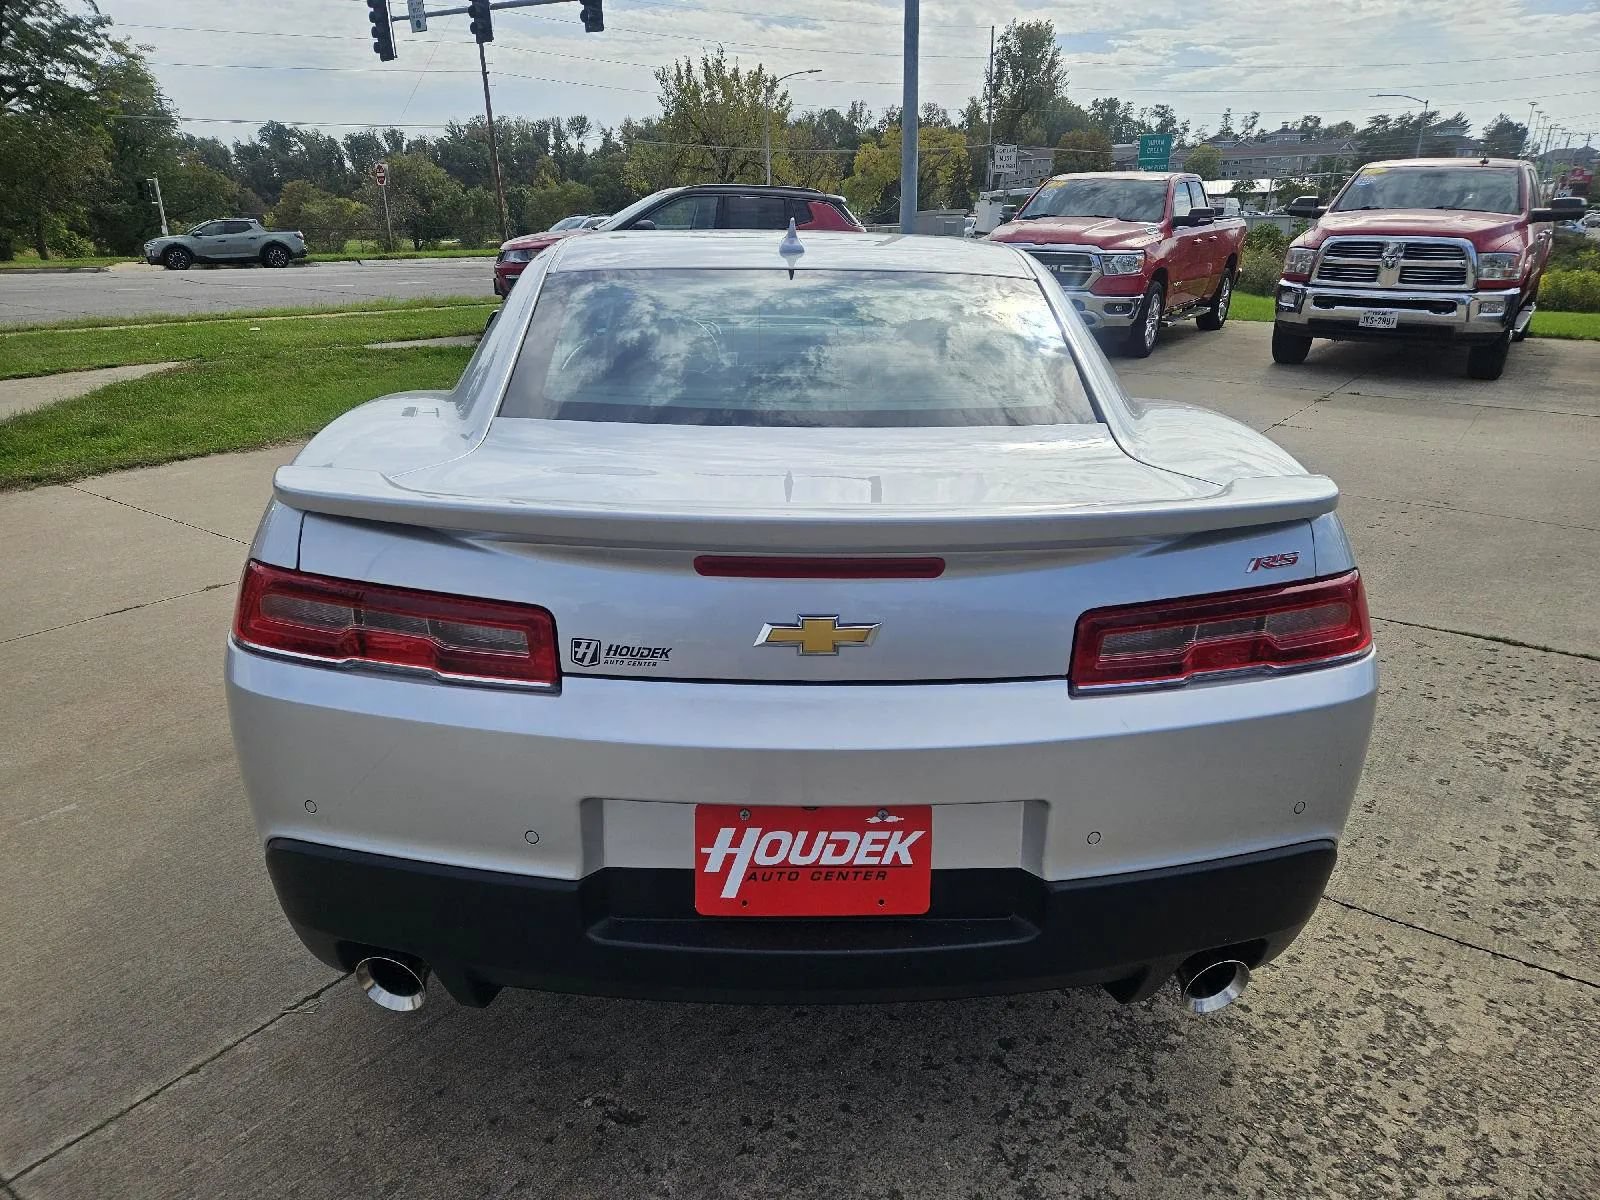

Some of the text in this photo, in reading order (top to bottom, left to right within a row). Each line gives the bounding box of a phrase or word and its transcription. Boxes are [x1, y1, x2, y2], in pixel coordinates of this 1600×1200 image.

[1245, 551, 1300, 573] RS
[605, 644, 672, 659] HOUDEK
[700, 827, 927, 899] HOUDEK
[747, 871, 888, 882] AUTO CENTER
